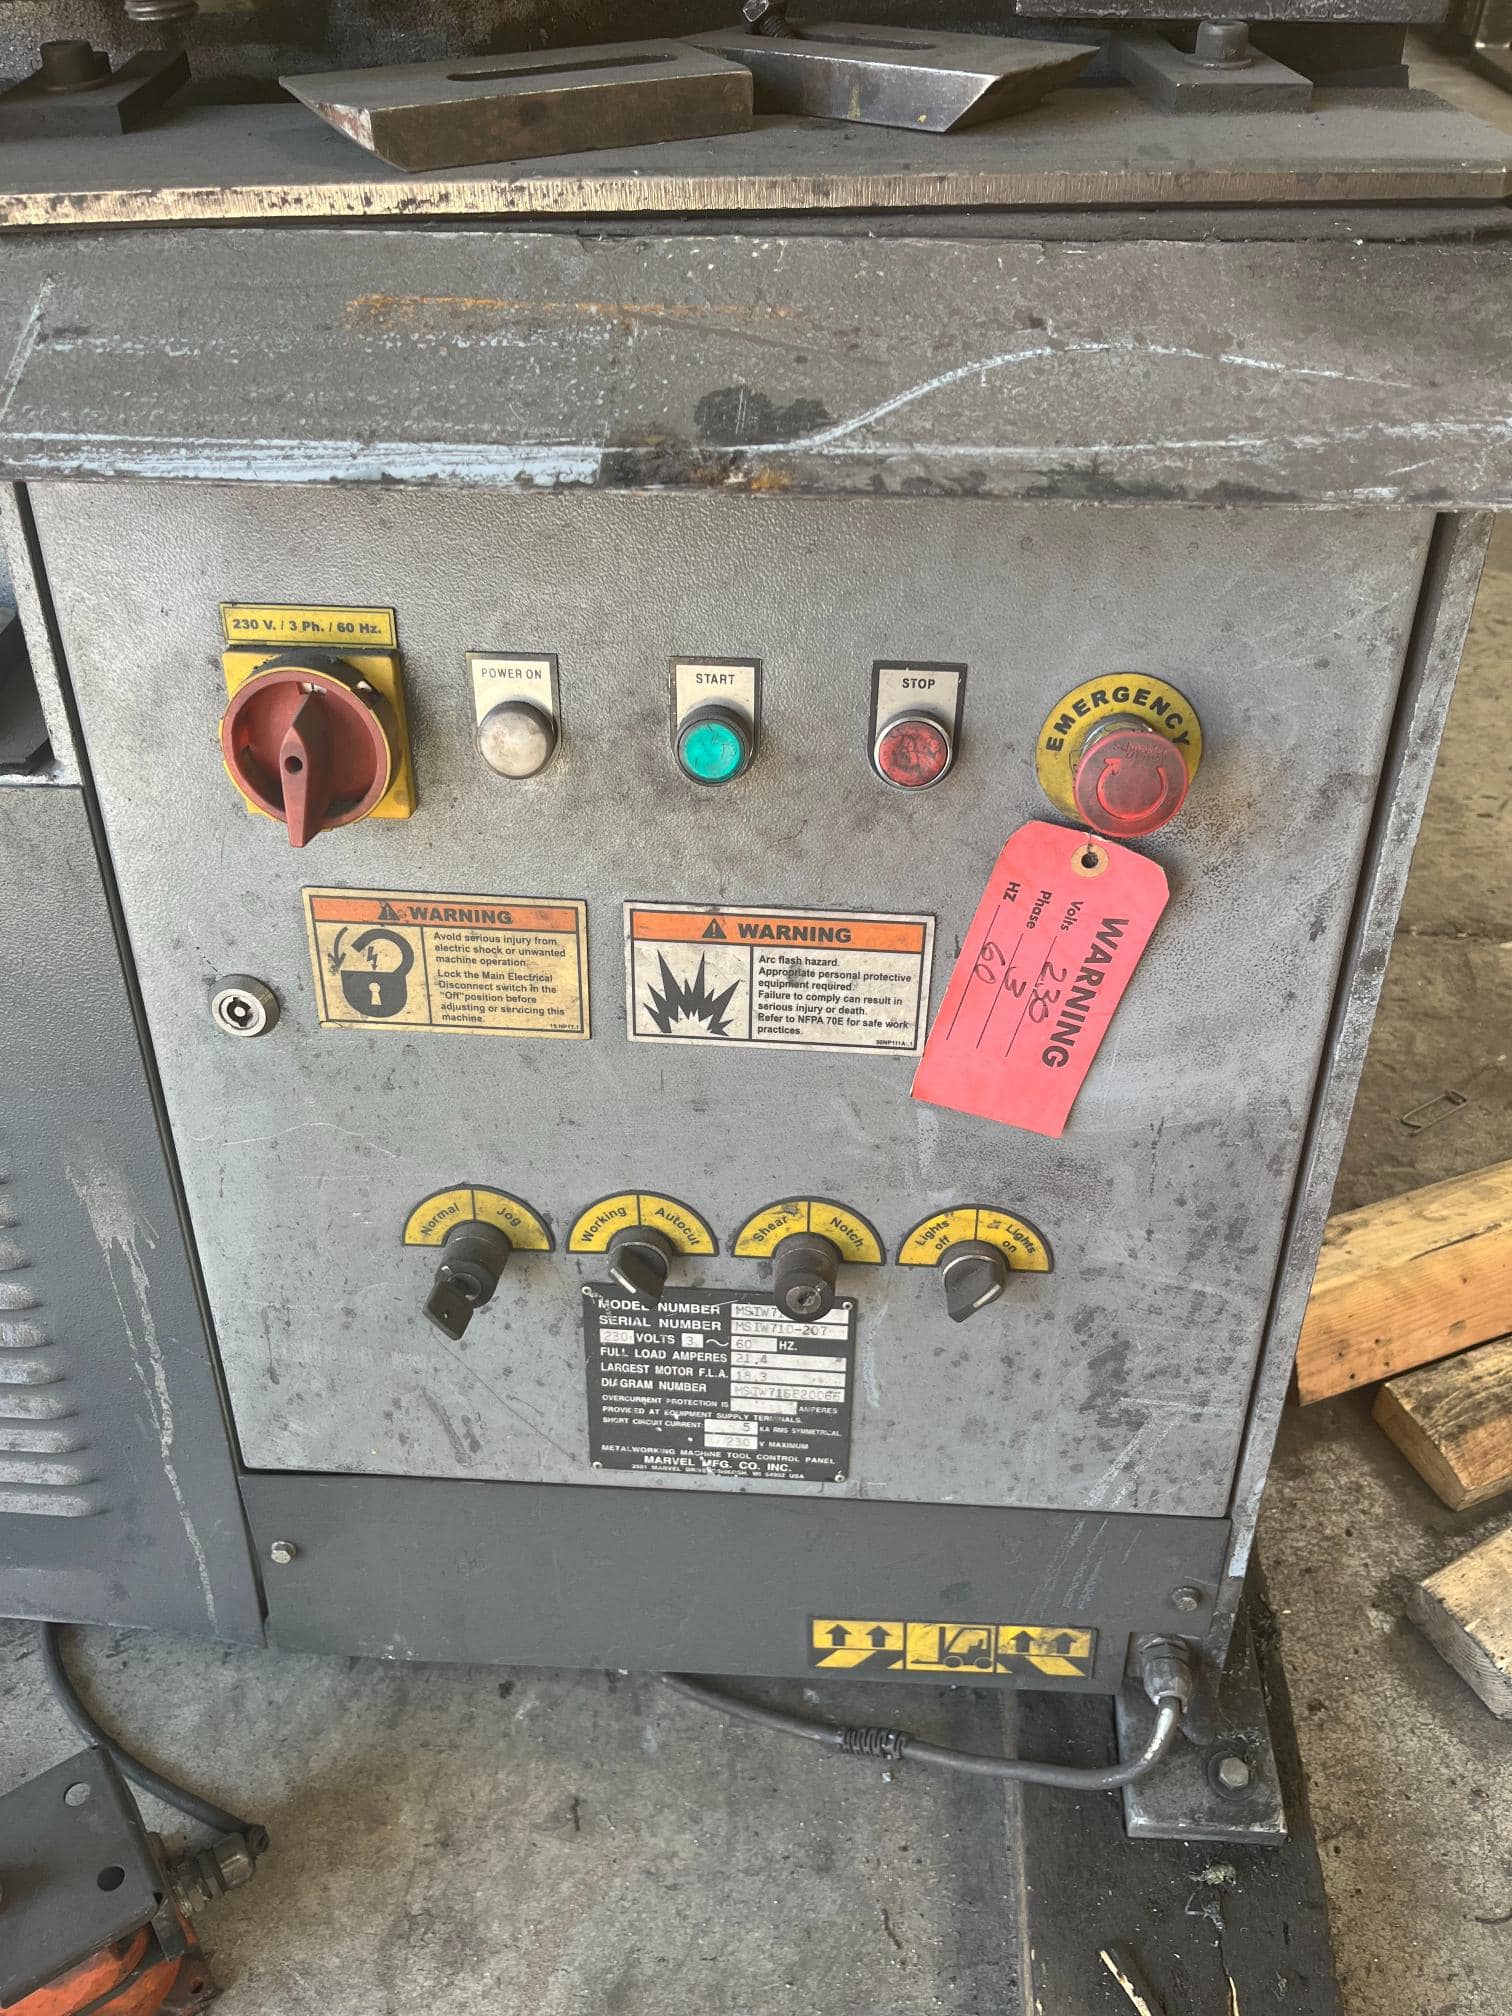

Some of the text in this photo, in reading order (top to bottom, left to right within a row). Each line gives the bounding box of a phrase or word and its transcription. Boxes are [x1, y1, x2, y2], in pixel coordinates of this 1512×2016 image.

[232, 619, 261, 630] 230
[264, 620, 276, 631] V.
[289, 620, 298, 632] 3
[301, 620, 324, 632] Ph.
[337, 622, 354, 633] 60
[358, 622, 382, 634] Hz.
[481, 667, 542, 681] POWER ON
[696, 673, 736, 685] START
[902, 678, 935, 690] STOP
[1046, 686, 1190, 752] EMERGENCY
[409, 906, 512, 924] WARNING
[1026, 890, 1052, 930] Phase
[434, 932, 557, 946] Avoid serious injury from
[738, 922, 852, 943] WARNING
[975, 881, 1020, 984] HZ 60
[435, 944, 470, 954] electric
[473, 946, 502, 955] shock
[519, 948, 566, 957] unwanted
[436, 955, 528, 968] machine operation.
[758, 955, 839, 968] Arc flash hazard.
[1028, 900, 1084, 1023] Volts 230
[438, 970, 552, 982] Lock the Main Electrical
[758, 967, 912, 984] Appropriate personal protective
[439, 981, 556, 994] Disconnect switch in the
[758, 980, 809, 990] equipment
[1042, 916, 1130, 1068] WARNING
[465, 992, 503, 1003] position
[506, 994, 536, 1004] before
[758, 990, 791, 1000] Failure
[806, 993, 840, 1004] comply
[864, 996, 892, 1005] result
[894, 997, 902, 1005] in
[441, 1003, 485, 1014] adjusting
[501, 1006, 544, 1016] servicing
[548, 1007, 565, 1016] this
[758, 1002, 794, 1012] serious
[796, 1004, 823, 1015] injury
[838, 1006, 868, 1016] death.
[442, 1013, 485, 1023] machine.
[758, 1013, 783, 1022] Refer
[798, 1015, 824, 1024] NFPA
[826, 1016, 844, 1026] 70E
[846, 1018, 860, 1026] for
[862, 1018, 883, 1028] safe
[885, 1020, 908, 1028] work
[758, 1025, 802, 1035] practices.
[421, 1202, 460, 1236] Normal
[497, 1206, 522, 1228] Jog
[582, 1206, 628, 1242] Working
[654, 1207, 700, 1246] Autocut
[752, 1214, 788, 1242] Shear
[830, 1216, 864, 1248] Notch
[915, 1219, 950, 1247] Lights
[935, 1237, 950, 1251] off
[1005, 1224, 1036, 1254] Lights
[1002, 1240, 1018, 1254] on
[658, 1302, 720, 1315] NUMBER
[600, 1315, 650, 1327] SERIAL
[659, 1318, 722, 1331] NUMBER
[604, 1331, 798, 1352] 230 VOLTS 3 60 HZ.
[601, 1347, 768, 1366] FULL LOAD AMPERES 21.4
[601, 1363, 650, 1374] LARGEST
[655, 1365, 693, 1376] MOTOR
[699, 1367, 728, 1379] F.L.A.
[602, 1378, 654, 1390] DIAGRAM
[659, 1380, 706, 1393] NUMBER
[602, 1394, 662, 1404] OVERCURRENT
[666, 1398, 718, 1407] PROTECTION
[798, 1406, 838, 1414] AMPERES
[602, 1406, 645, 1414] PROVIDED
[664, 1409, 712, 1418] EQUIPMENT
[716, 1412, 749, 1420] SUPPLY
[602, 1416, 628, 1424] SHORT
[632, 1418, 662, 1426] CIRCUIT
[743, 1422, 750, 1432] 5
[768, 1442, 809, 1450] MAXIMUM
[601, 1444, 836, 1464] METALWORKING MACHINE TOOL CONTROL PANEL
[644, 1455, 792, 1472] MARVEL MFG. CO. INC.
